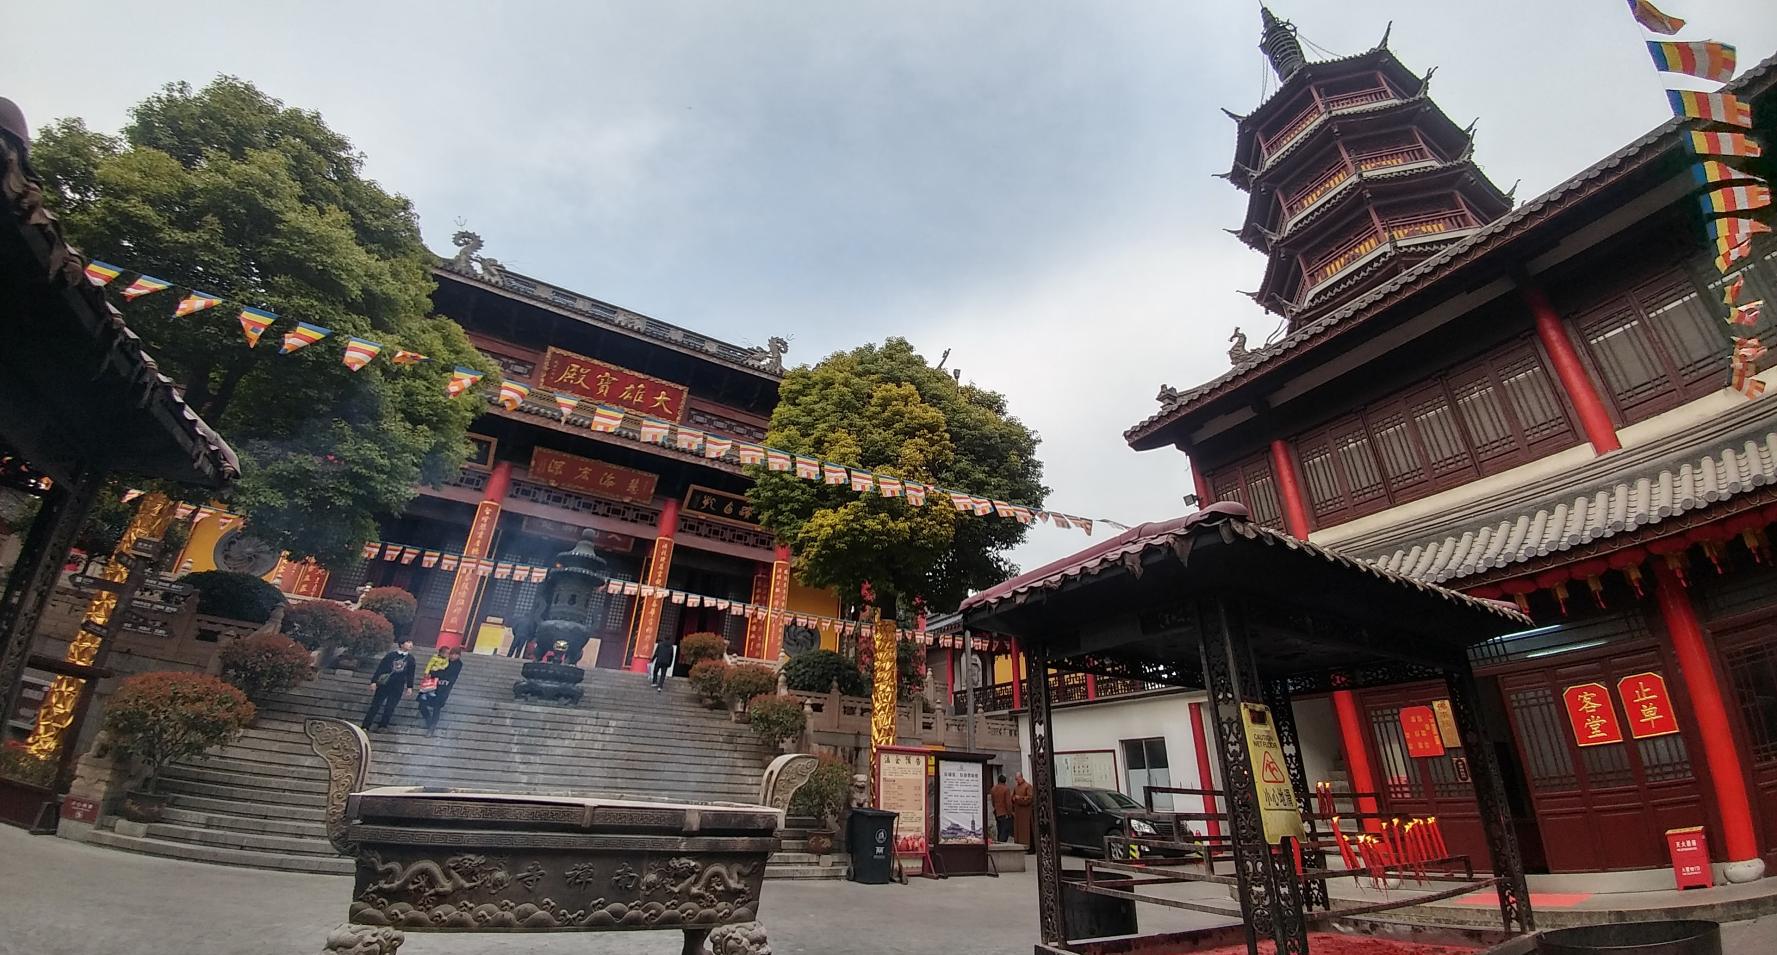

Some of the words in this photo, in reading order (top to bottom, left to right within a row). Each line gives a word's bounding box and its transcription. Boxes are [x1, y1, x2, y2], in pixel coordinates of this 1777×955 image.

[554, 363, 673, 414] 大雄寶殿
[1578, 691, 1608, 738] 客堂
[1633, 681, 1664, 729] 止单
[1263, 741, 1278, 749] FLOOR
